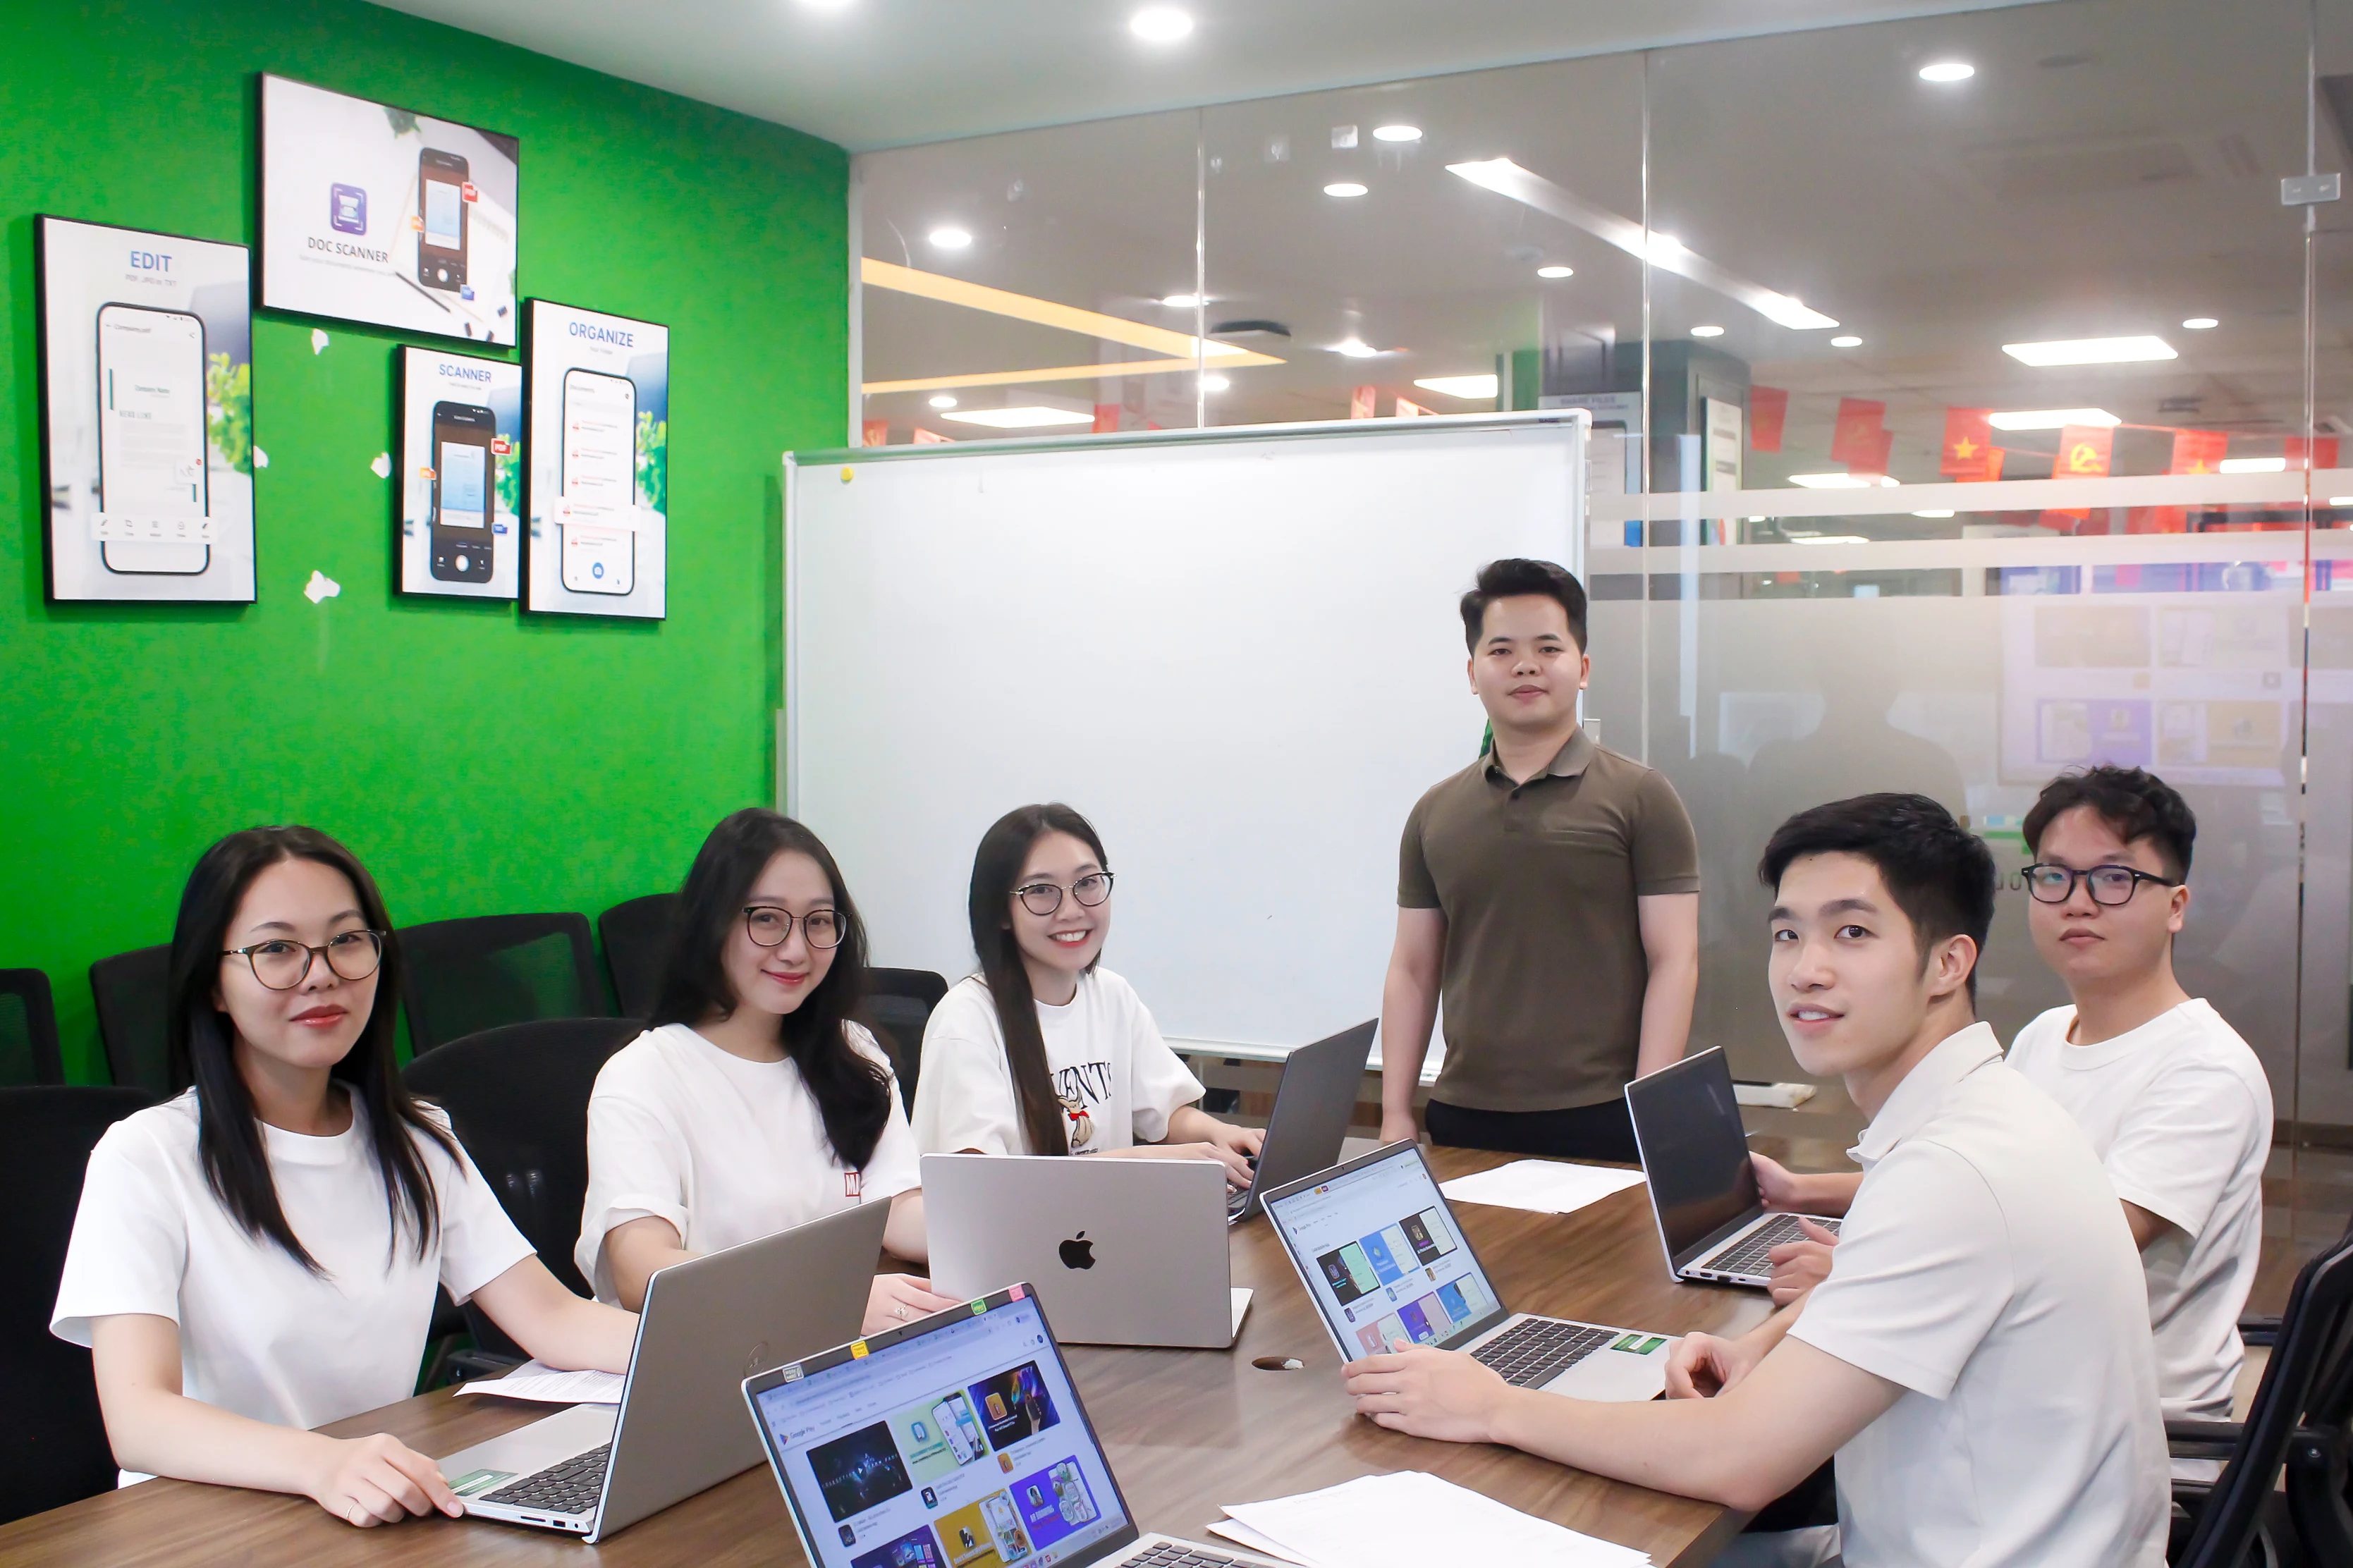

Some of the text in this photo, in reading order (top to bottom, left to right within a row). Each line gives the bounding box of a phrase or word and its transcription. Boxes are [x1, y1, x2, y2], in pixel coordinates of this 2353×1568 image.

[130, 250, 173, 272] EDIT
[307, 236, 389, 264] DOC SCANNER
[569, 321, 634, 348] ORGANIZE
[439, 363, 492, 384] SCANNER
